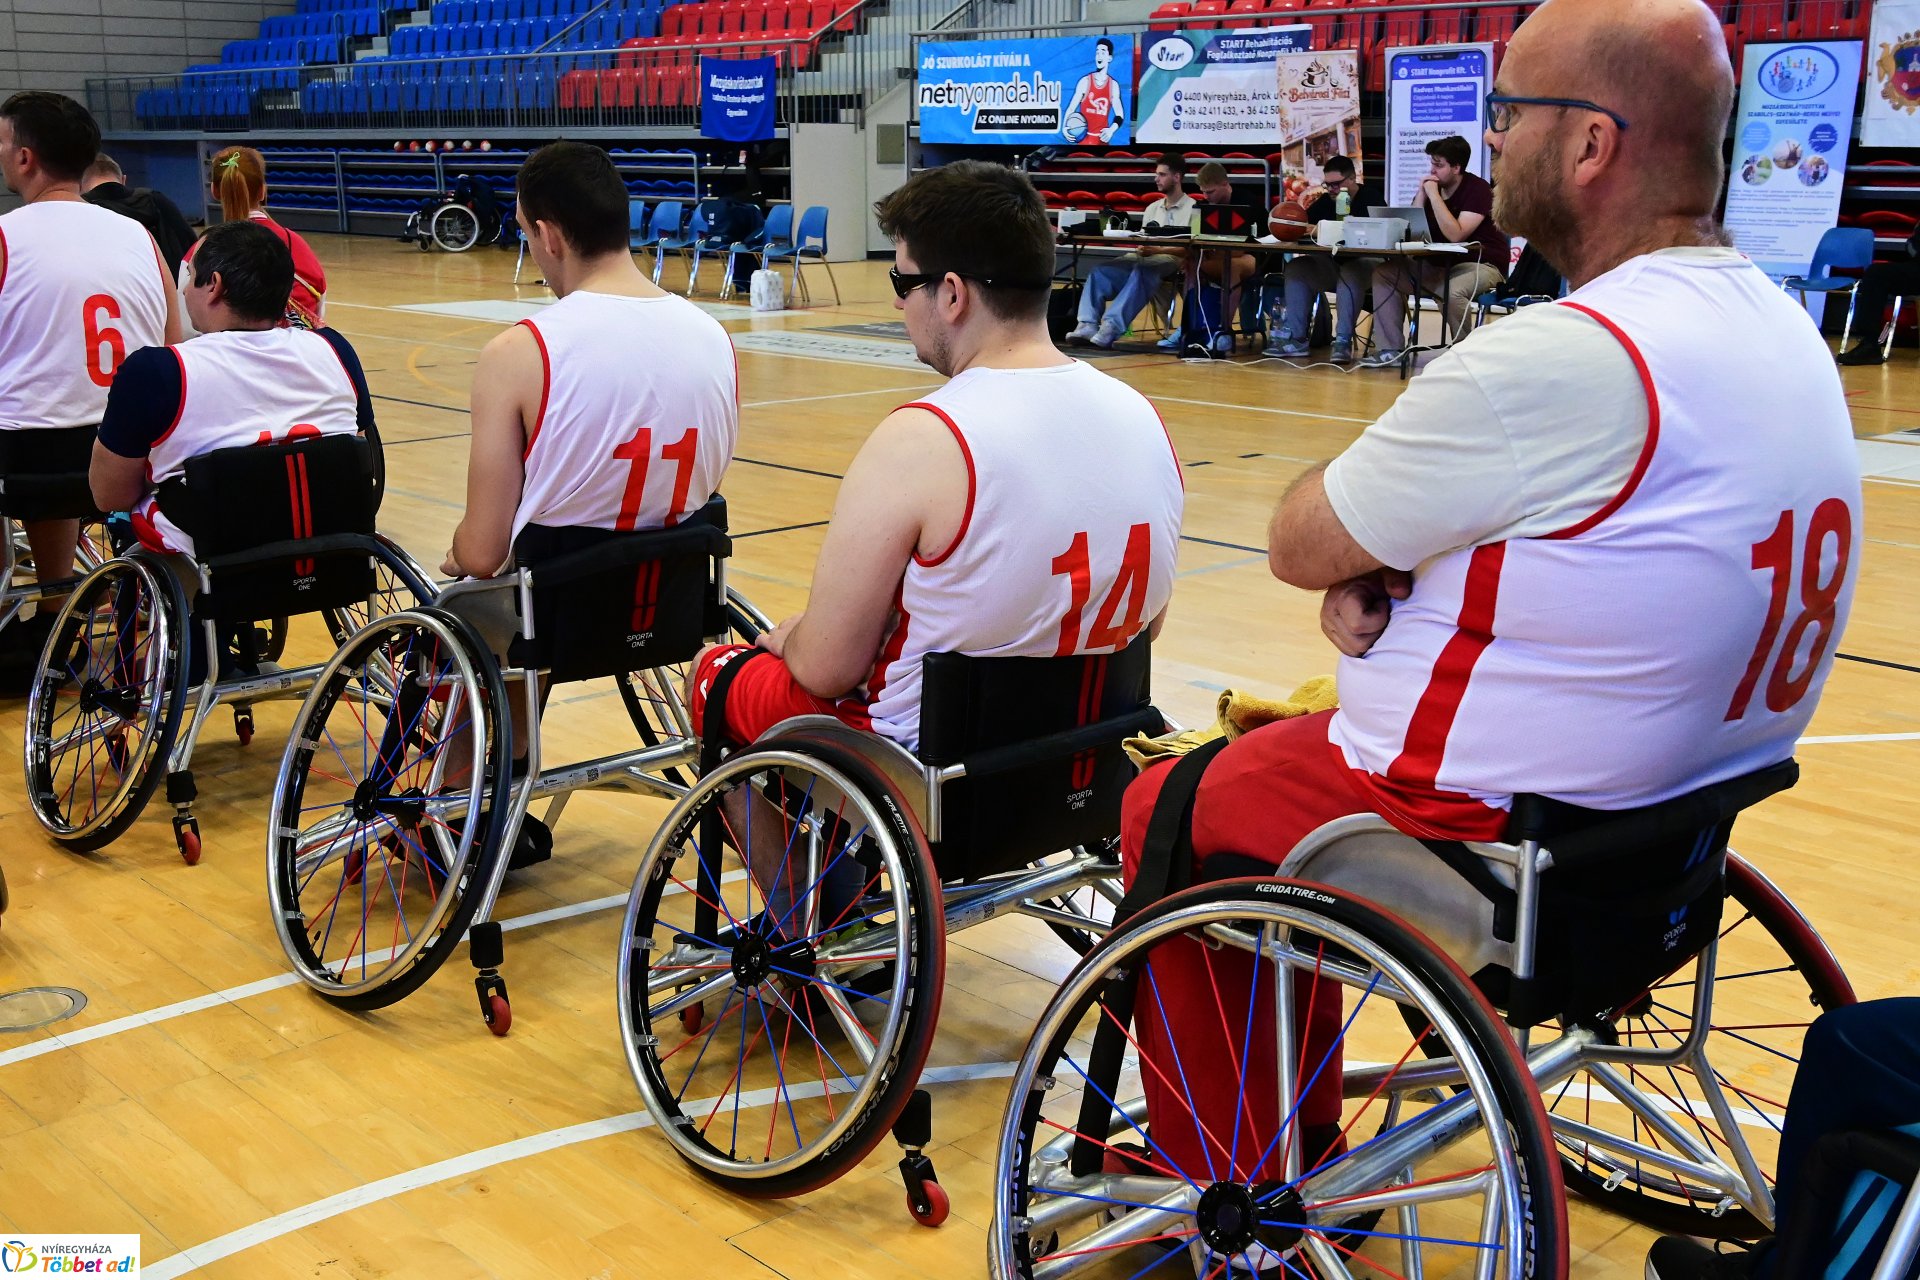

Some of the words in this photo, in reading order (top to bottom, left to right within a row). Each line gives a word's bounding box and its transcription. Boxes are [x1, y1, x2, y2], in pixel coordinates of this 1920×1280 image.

[1221, 39, 1244, 49] START
[922, 54, 935, 69] JÓ
[937, 53, 992, 69] SZURKOLÁST
[993, 52, 1022, 67] KÍVÁN
[1023, 54, 1031, 67] A
[1157, 46, 1185, 62] Start
[920, 73, 1060, 113] netnyomda.hu
[1184, 92, 1201, 101] 4400
[1203, 90, 1249, 104] Nyíregyháza,
[1252, 89, 1271, 100] Árok
[1184, 106, 1196, 115] +36
[1199, 106, 1207, 115] 42
[1209, 106, 1221, 115] 411
[1247, 106, 1257, 115] 36
[1259, 106, 1268, 115] 42
[977, 114, 987, 124] AZ
[989, 114, 1019, 124] ONLINE
[1020, 114, 1056, 124] NYOMDA
[1183, 120, 1277, 132] titkarsag@startrehab.hu
[82, 293, 127, 388] 6
[612, 427, 699, 533] 11
[293, 576, 316, 586] SPORTA
[298, 583, 311, 591] ONE
[1051, 522, 1151, 658] 14
[1723, 497, 1852, 723] 18
[626, 632, 653, 643] SPORTA
[631, 639, 646, 649] ONE
[1066, 788, 1093, 804] SPORTA
[1071, 800, 1086, 811] ONE
[1255, 883, 1336, 905] KENDATIRE.COM
